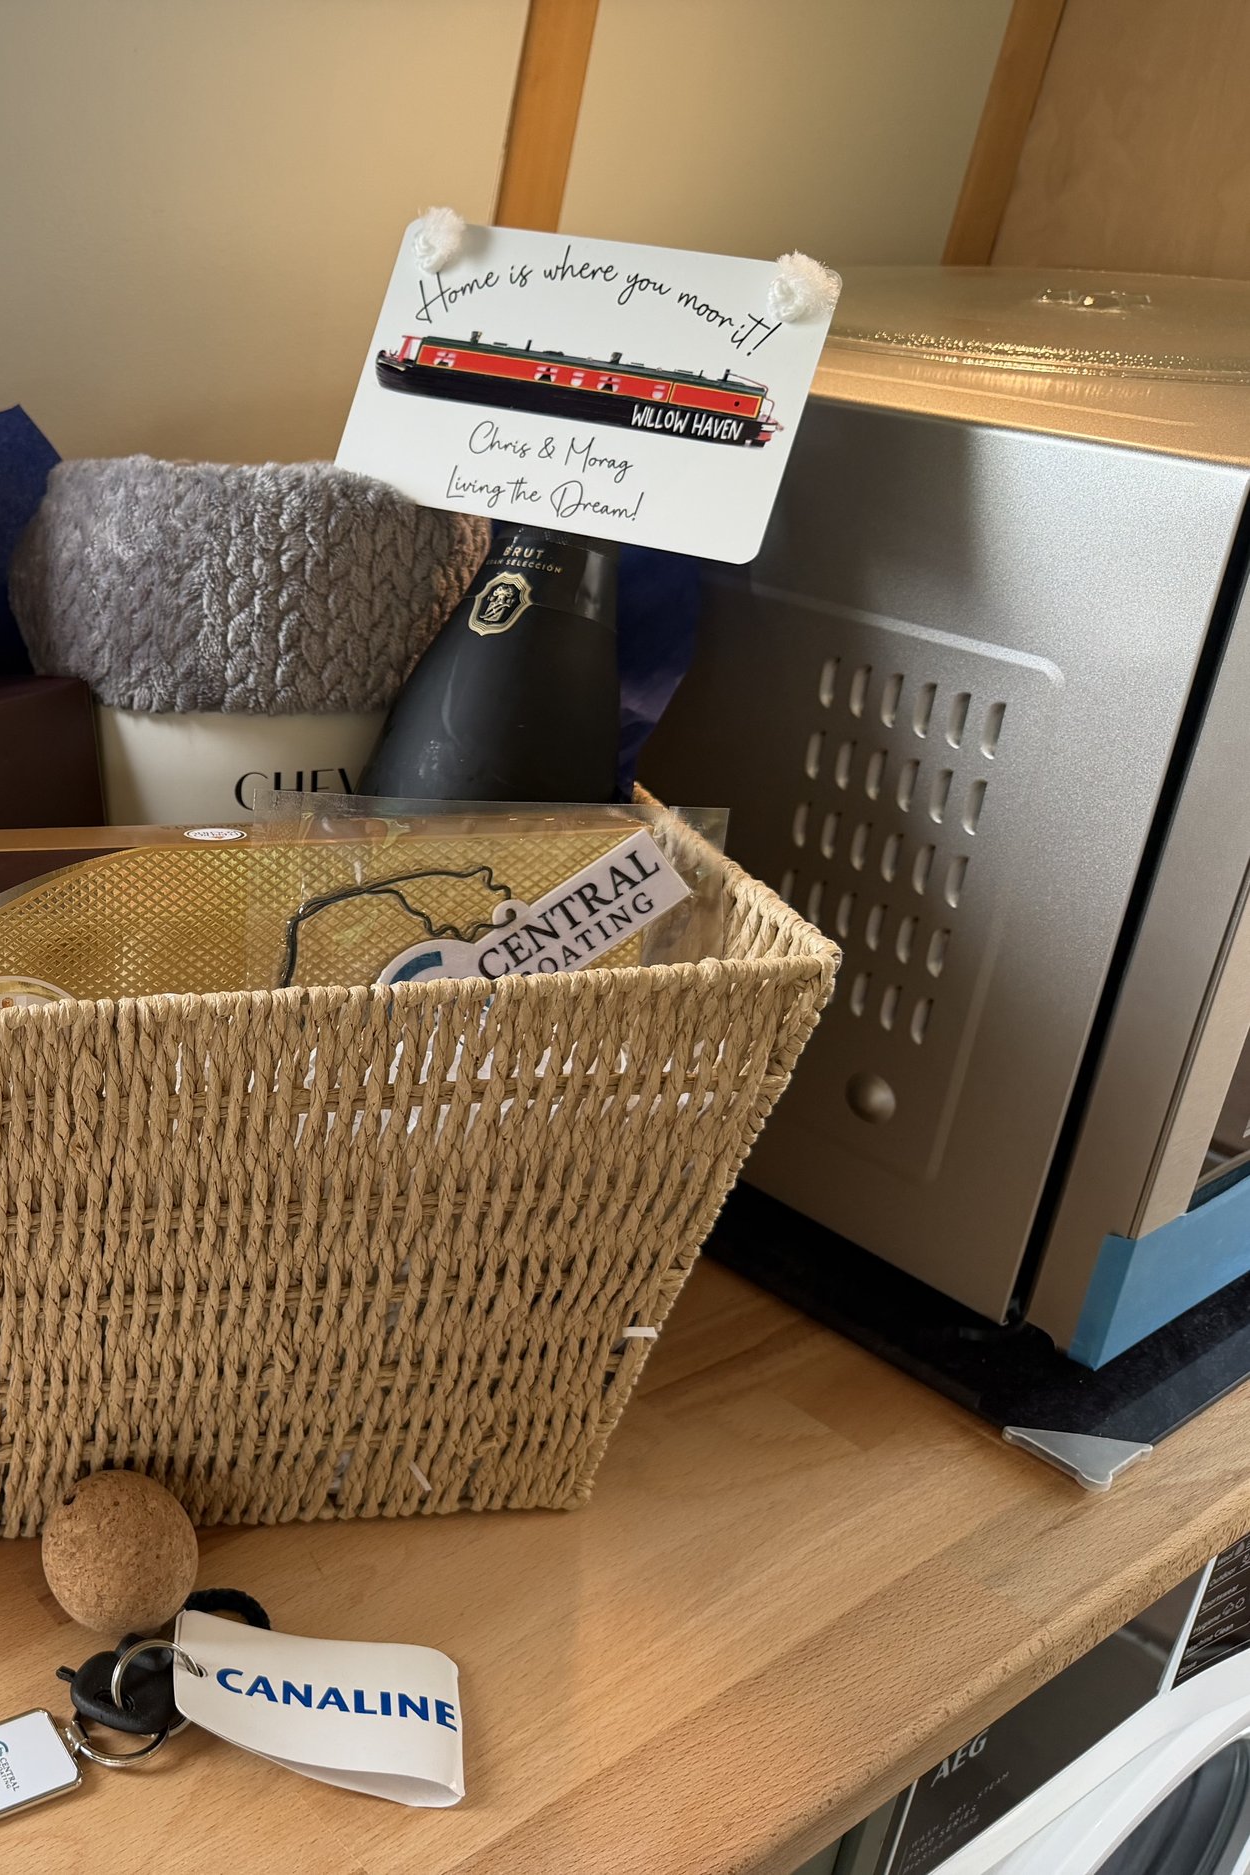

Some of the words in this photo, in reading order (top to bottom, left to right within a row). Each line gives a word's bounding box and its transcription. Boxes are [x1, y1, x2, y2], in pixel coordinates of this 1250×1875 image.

[415, 270, 500, 324] Home
[509, 263, 534, 288] is
[543, 245, 618, 282] where
[617, 272, 671, 306] you
[468, 420, 532, 459] Chris
[537, 436, 556, 460] &
[564, 436, 634, 484] Morag
[631, 403, 689, 434] WILLOW
[691, 412, 745, 441] HAVEN
[446, 464, 506, 508] Living
[506, 477, 542, 504] the
[550, 479, 645, 522] Dream!
[502, 545, 544, 560] BRUT
[477, 849, 661, 981] CENTRAL
[522, 891, 655, 977] OATING
[215, 1666, 459, 1733] CANALINE
[0, 1757, 20, 1792] CENTRAL
[930, 1728, 990, 1788] AEG
